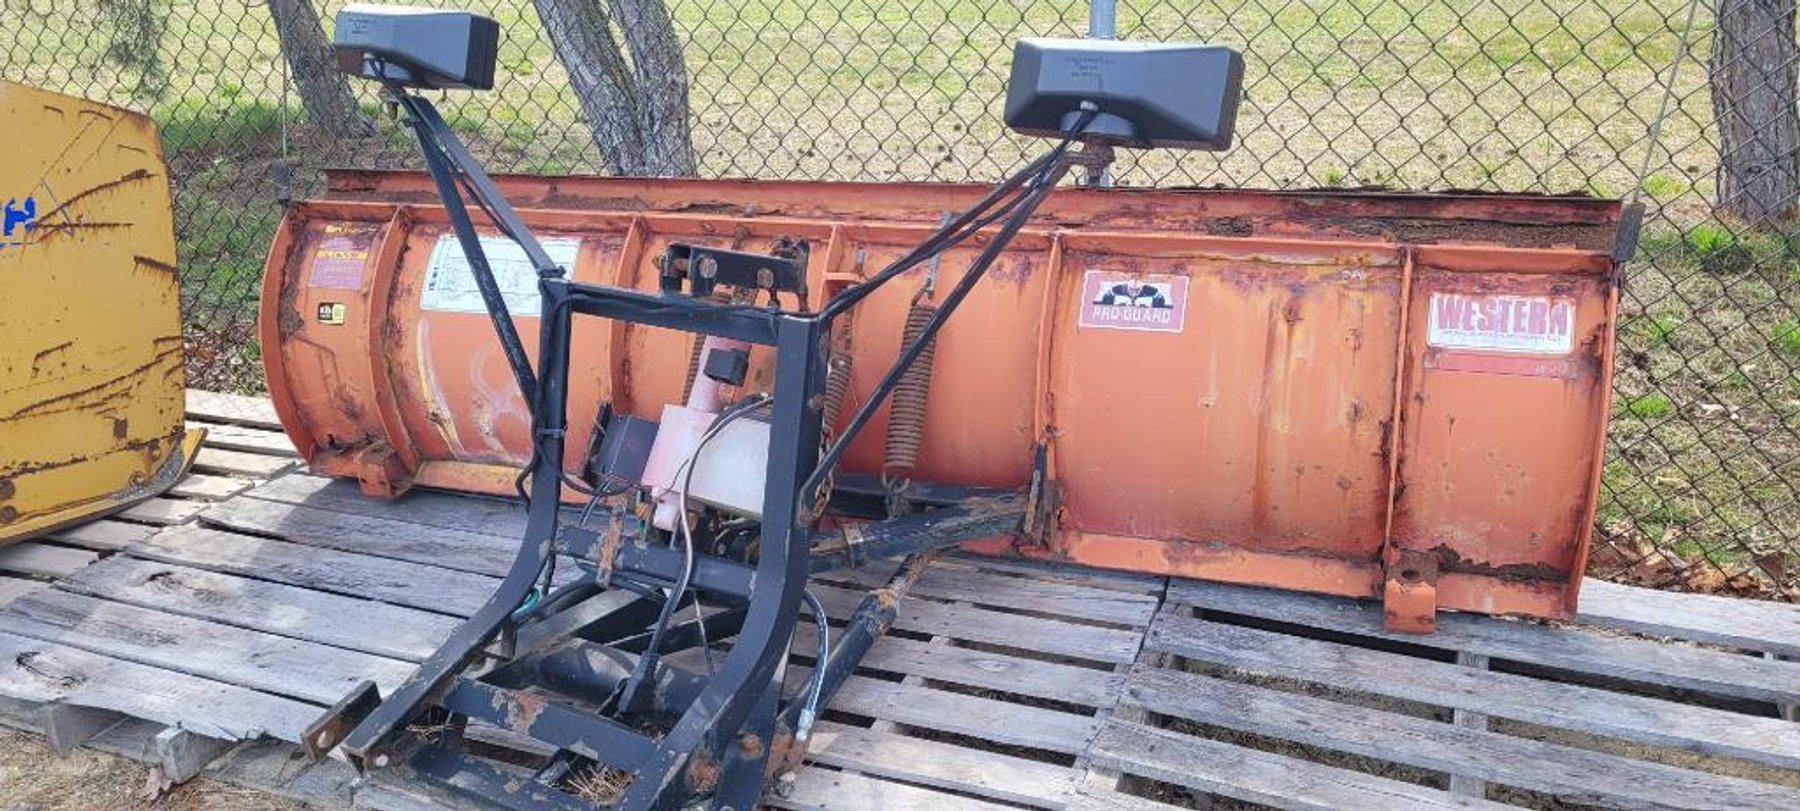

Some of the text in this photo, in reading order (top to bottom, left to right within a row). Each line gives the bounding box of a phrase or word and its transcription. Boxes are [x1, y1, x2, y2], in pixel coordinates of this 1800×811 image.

[1092, 305, 1171, 324] PRO GUARD
[1437, 297, 1568, 335] WESTERN
